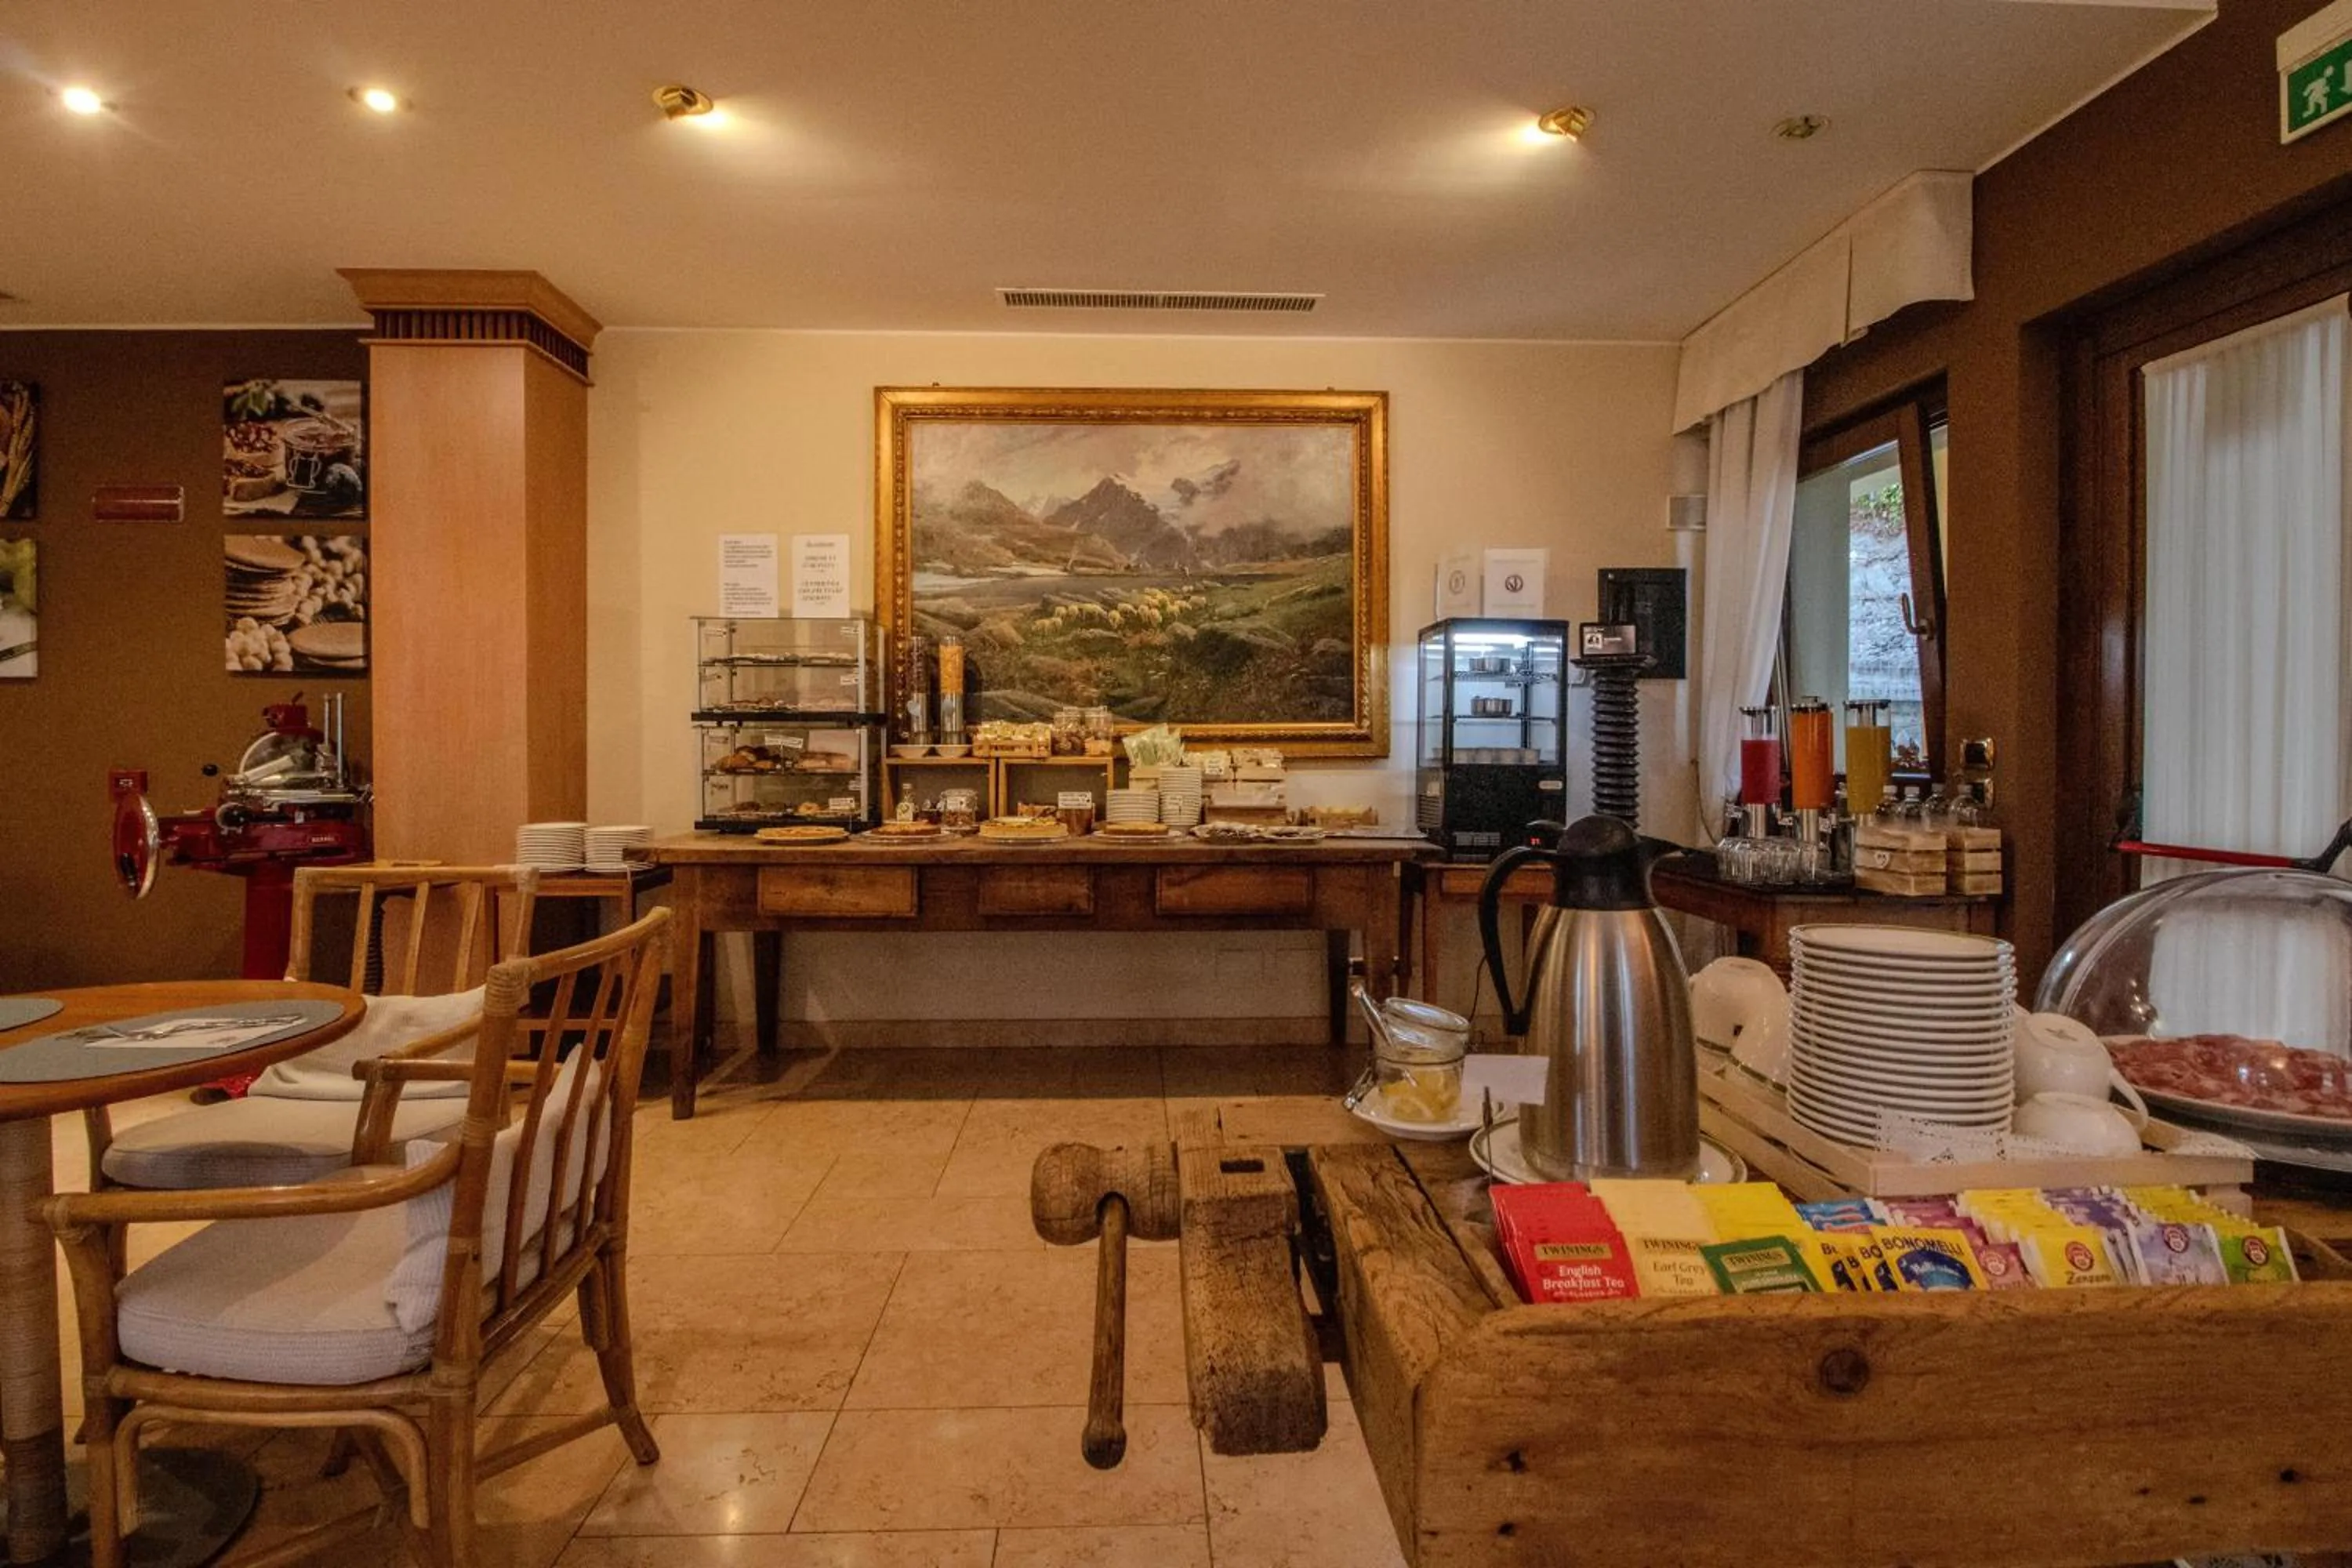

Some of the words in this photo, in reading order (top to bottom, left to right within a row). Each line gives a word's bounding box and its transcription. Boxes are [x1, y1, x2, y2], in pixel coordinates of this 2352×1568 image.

[1541, 1245, 1605, 1255] TWININGS
[1643, 1240, 1697, 1250] TWINING
[1882, 1236, 1964, 1256] BONOMELLI
[1559, 1265, 1602, 1279] English
[1653, 1261, 1676, 1272] Earl
[1679, 1261, 1705, 1276] Grey
[1543, 1277, 1600, 1290] Breakfast
[1603, 1276, 1624, 1287] Tea
[1672, 1274, 1694, 1285] Tea
